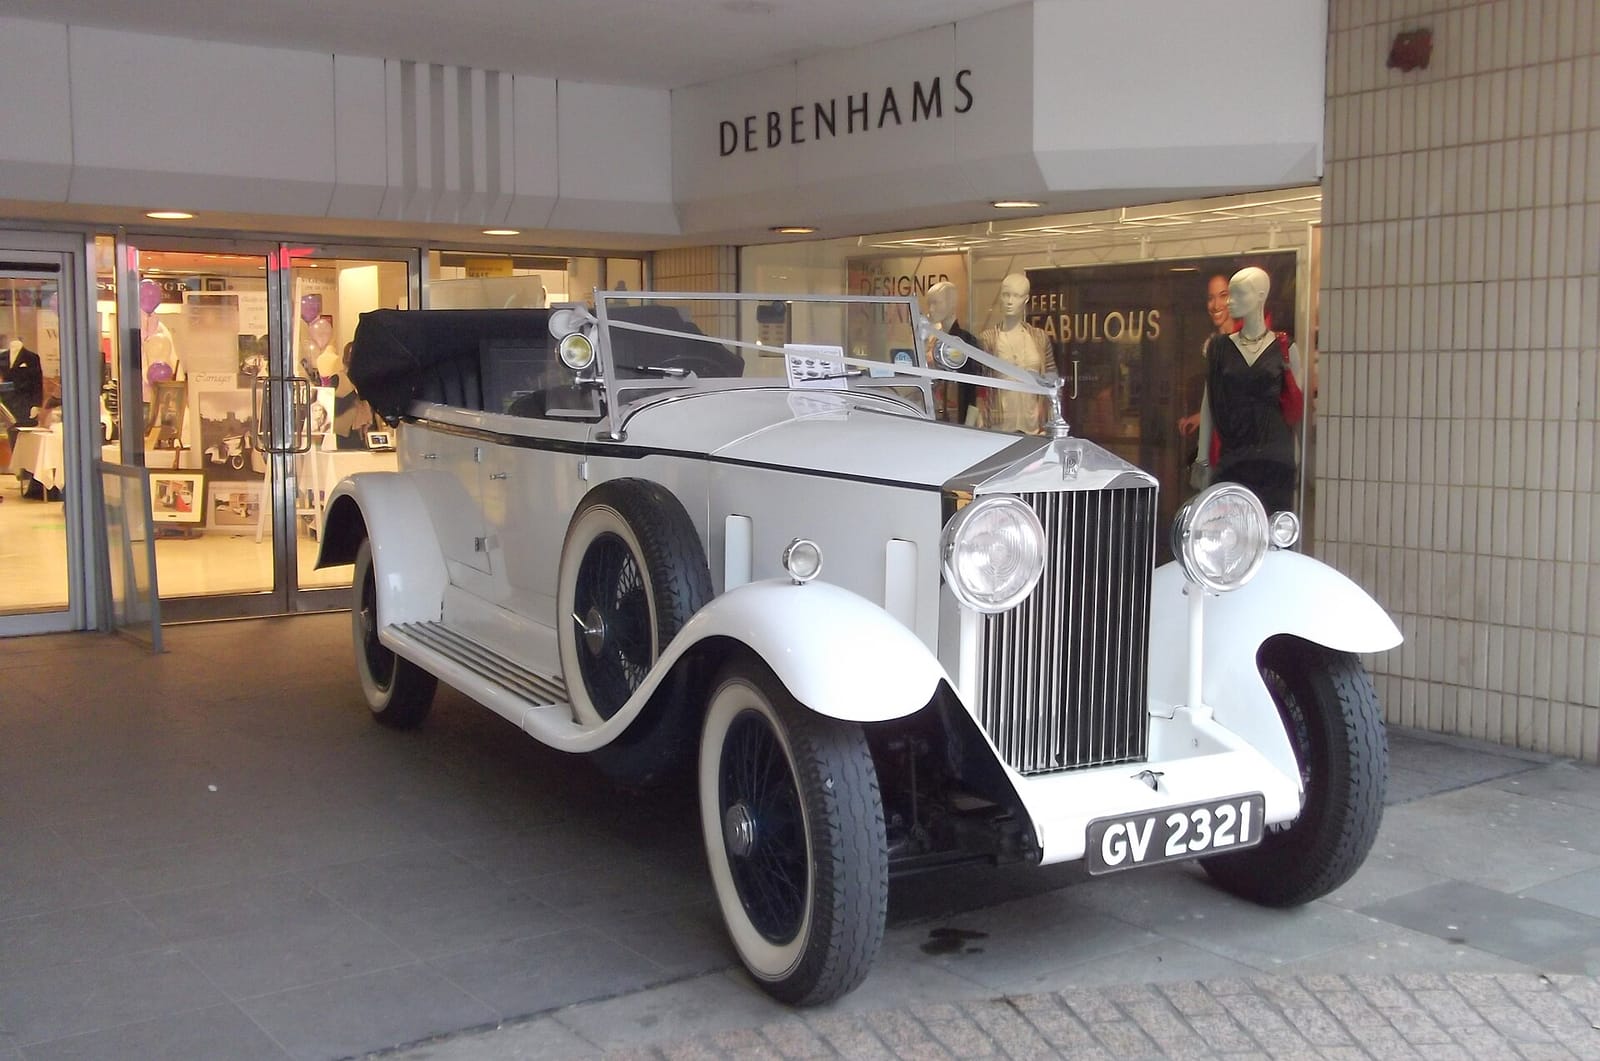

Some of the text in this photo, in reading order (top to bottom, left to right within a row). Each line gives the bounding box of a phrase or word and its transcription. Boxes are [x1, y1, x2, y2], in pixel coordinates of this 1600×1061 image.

[719, 69, 974, 157] DEBENHAMS
[1031, 294, 1067, 311] FEEL
[1070, 360, 1080, 400] J
[1101, 800, 1251, 866] GV 2321
